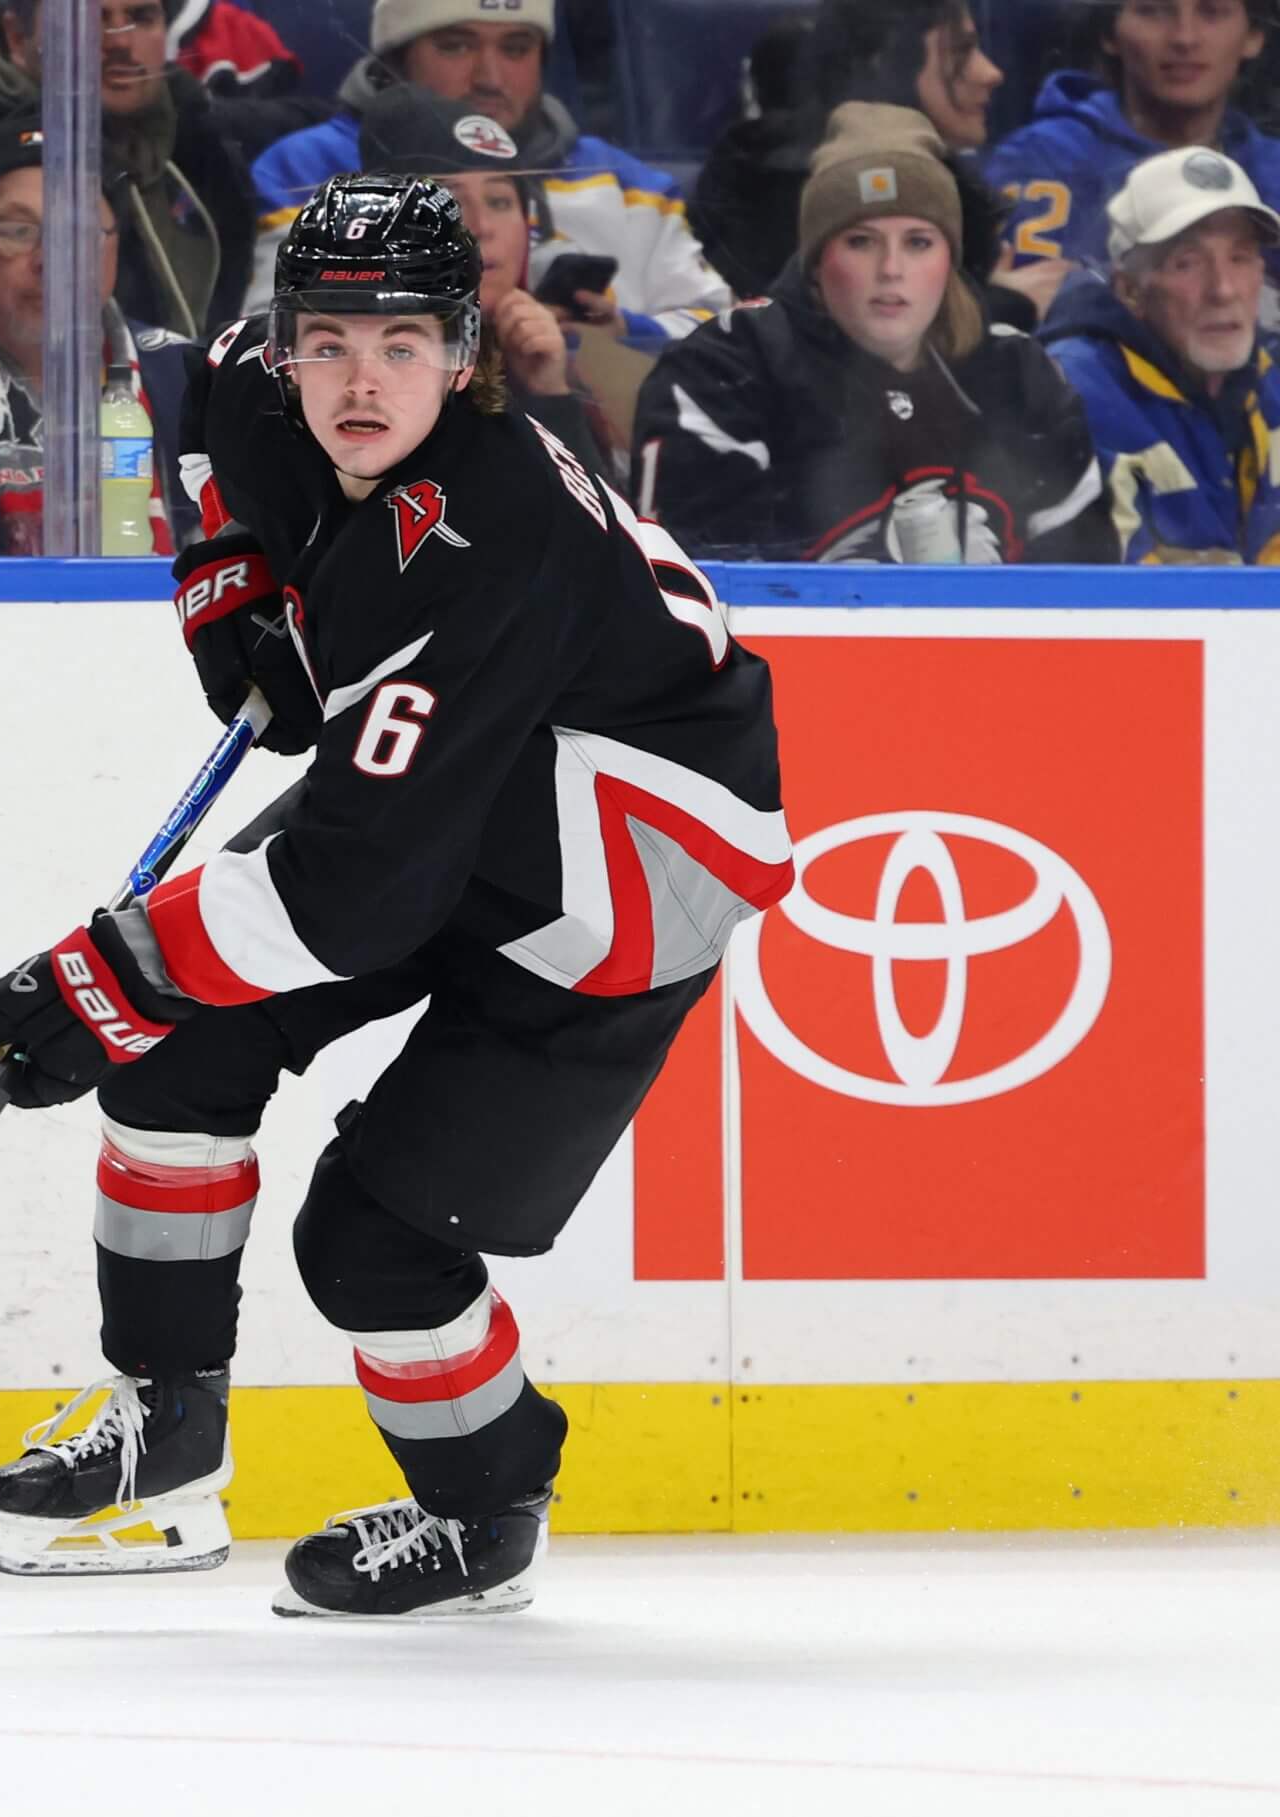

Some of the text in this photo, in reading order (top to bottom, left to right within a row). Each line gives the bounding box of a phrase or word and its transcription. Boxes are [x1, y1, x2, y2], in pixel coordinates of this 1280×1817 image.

[346, 217, 368, 240] 6
[999, 180, 1072, 257] 2
[320, 271, 385, 281] BAUER
[352, 681, 436, 778] 6
